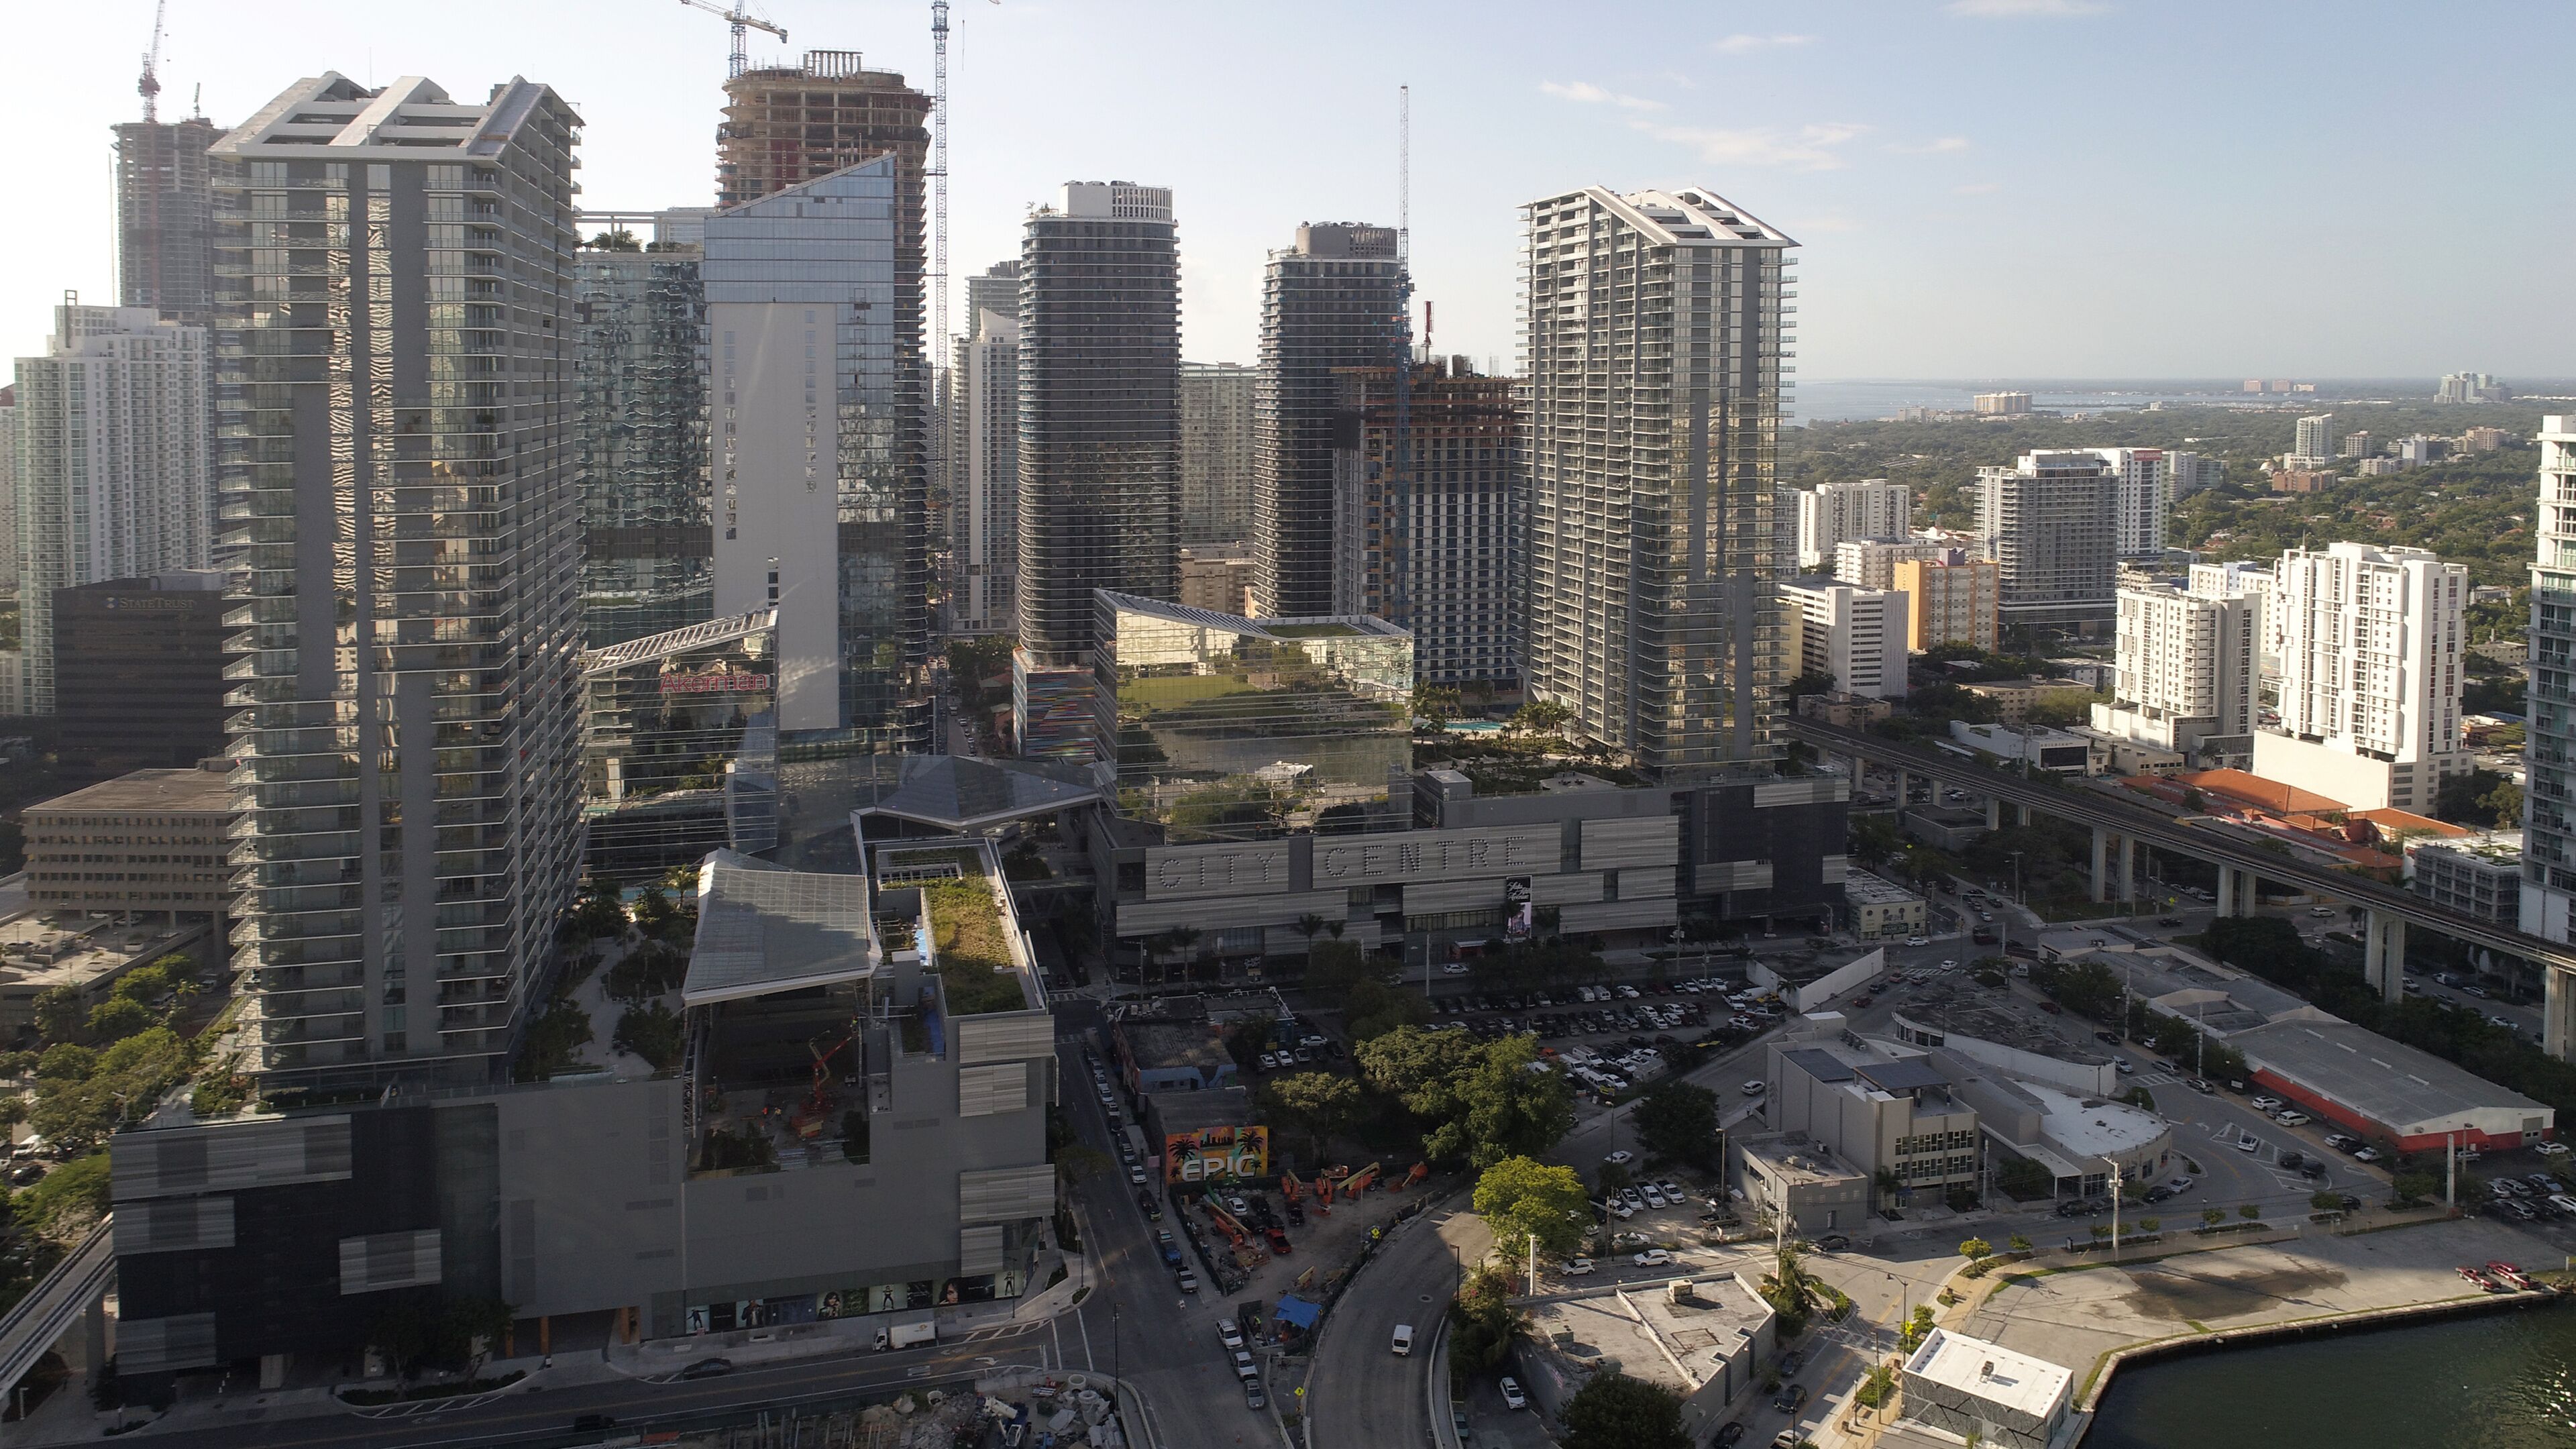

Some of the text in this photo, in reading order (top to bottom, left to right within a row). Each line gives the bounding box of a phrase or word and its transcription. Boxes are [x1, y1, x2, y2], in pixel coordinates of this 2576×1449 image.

[658, 672, 767, 694] Akerman
[1159, 836, 1525, 889] CITY CENTRE
[1182, 1154, 1255, 1182] EPIC
